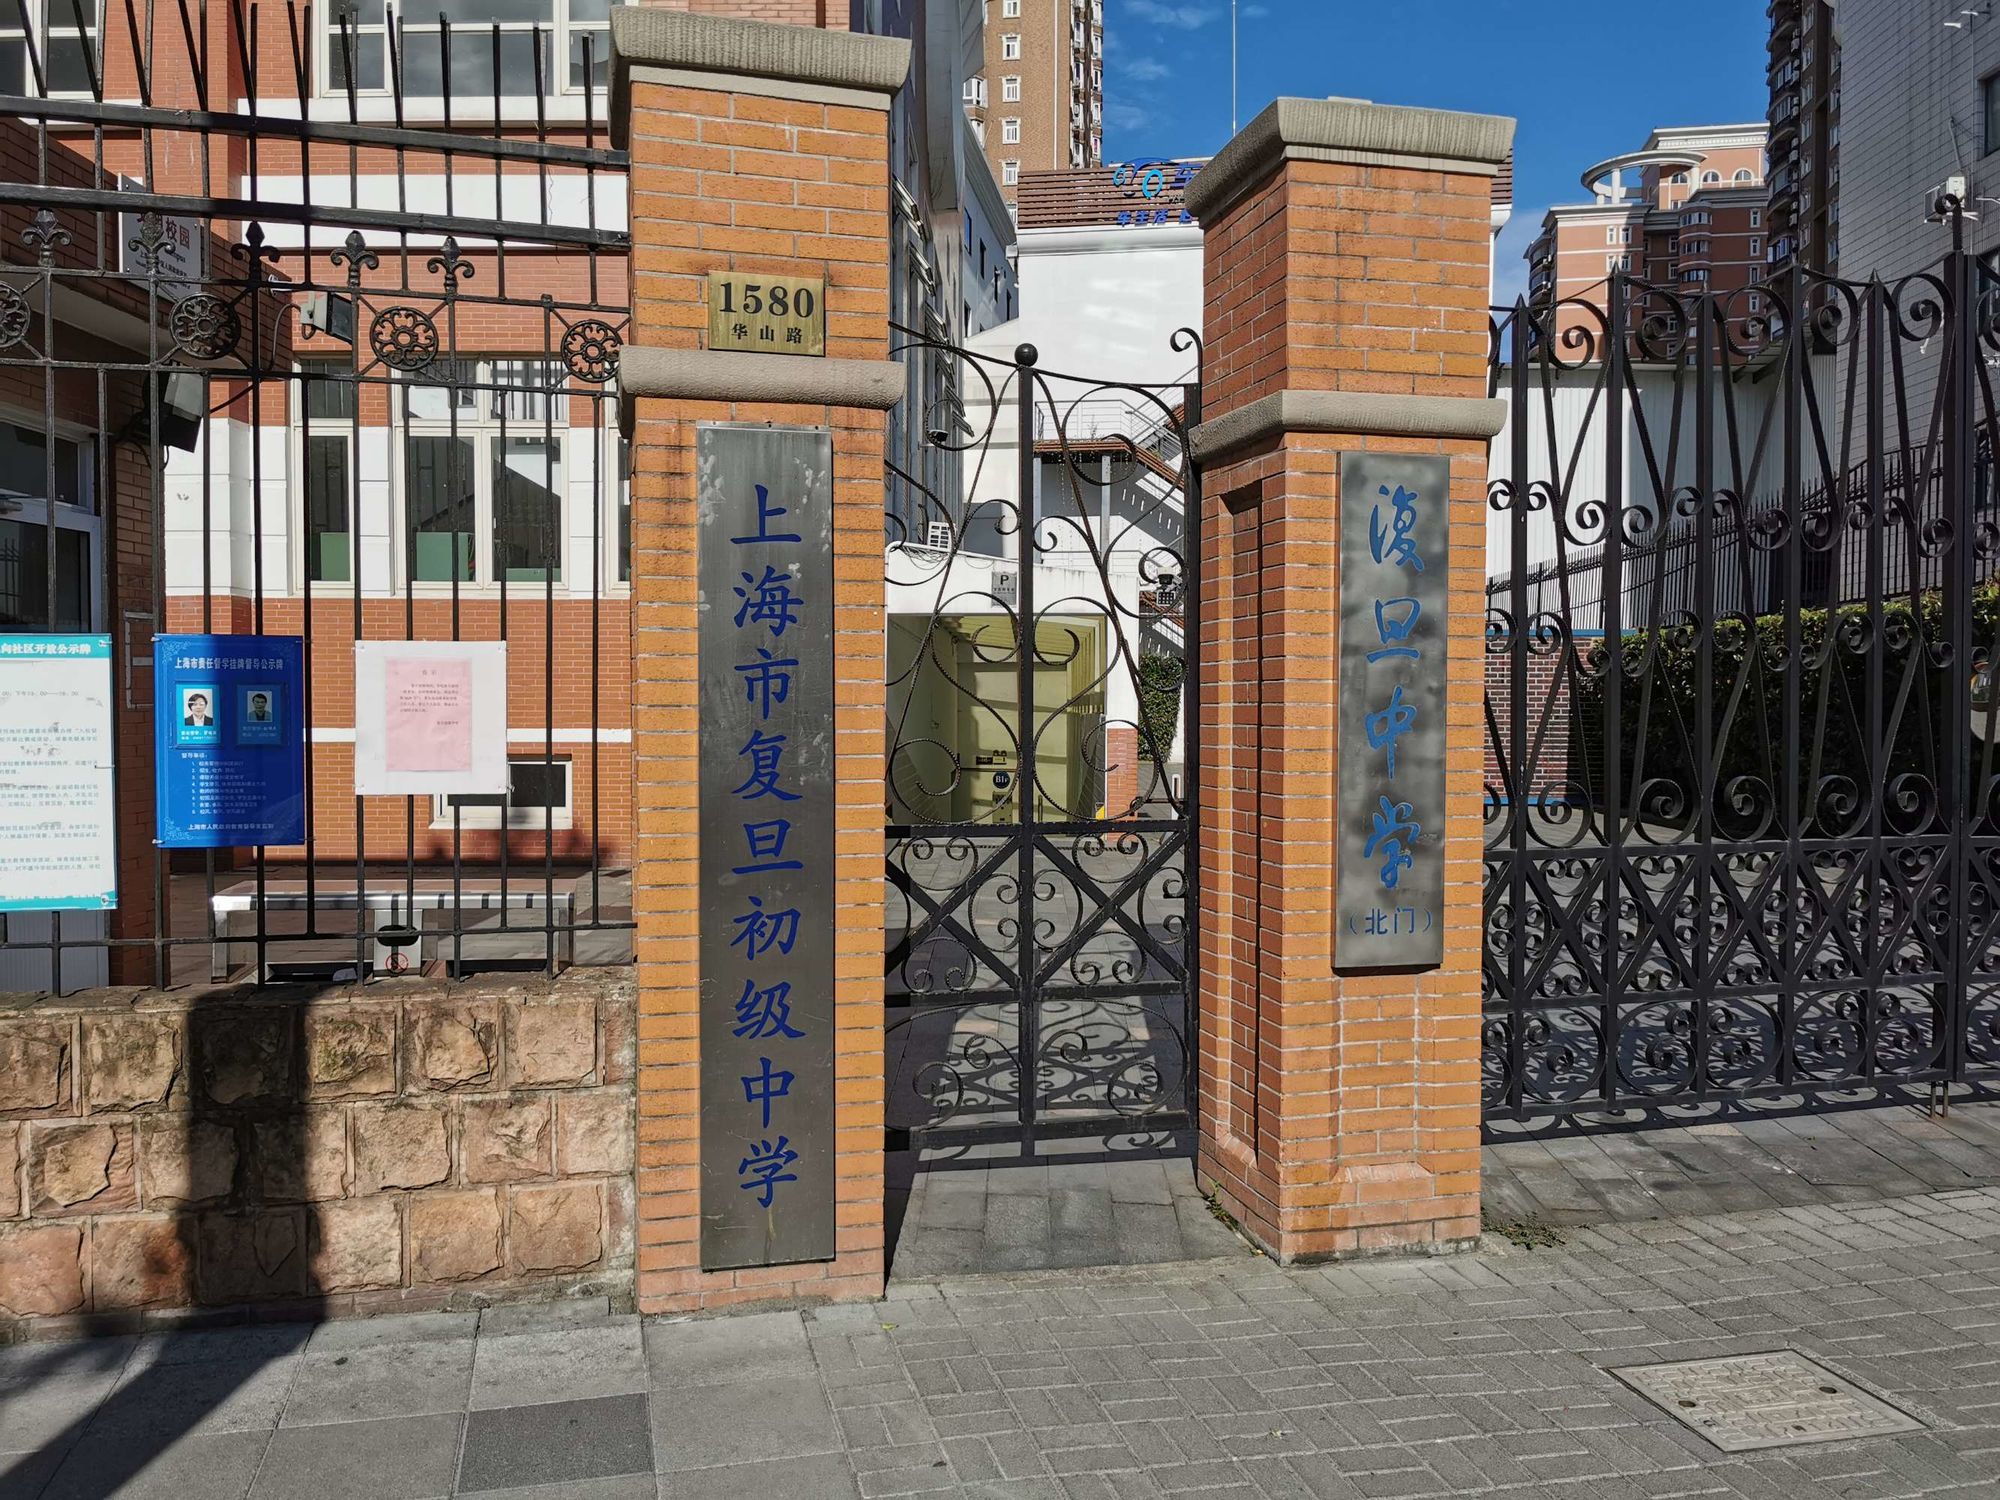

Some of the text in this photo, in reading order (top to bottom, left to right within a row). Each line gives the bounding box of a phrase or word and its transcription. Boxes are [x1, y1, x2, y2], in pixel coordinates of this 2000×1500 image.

[719, 282, 814, 318] 1580
[732, 323, 803, 344] 华山路
[1000, 574, 1009, 586] P
[174, 656, 284, 671] 上海市责任督学挂牌督导公示牌
[732, 483, 806, 1208] 上海市复旦初级中学
